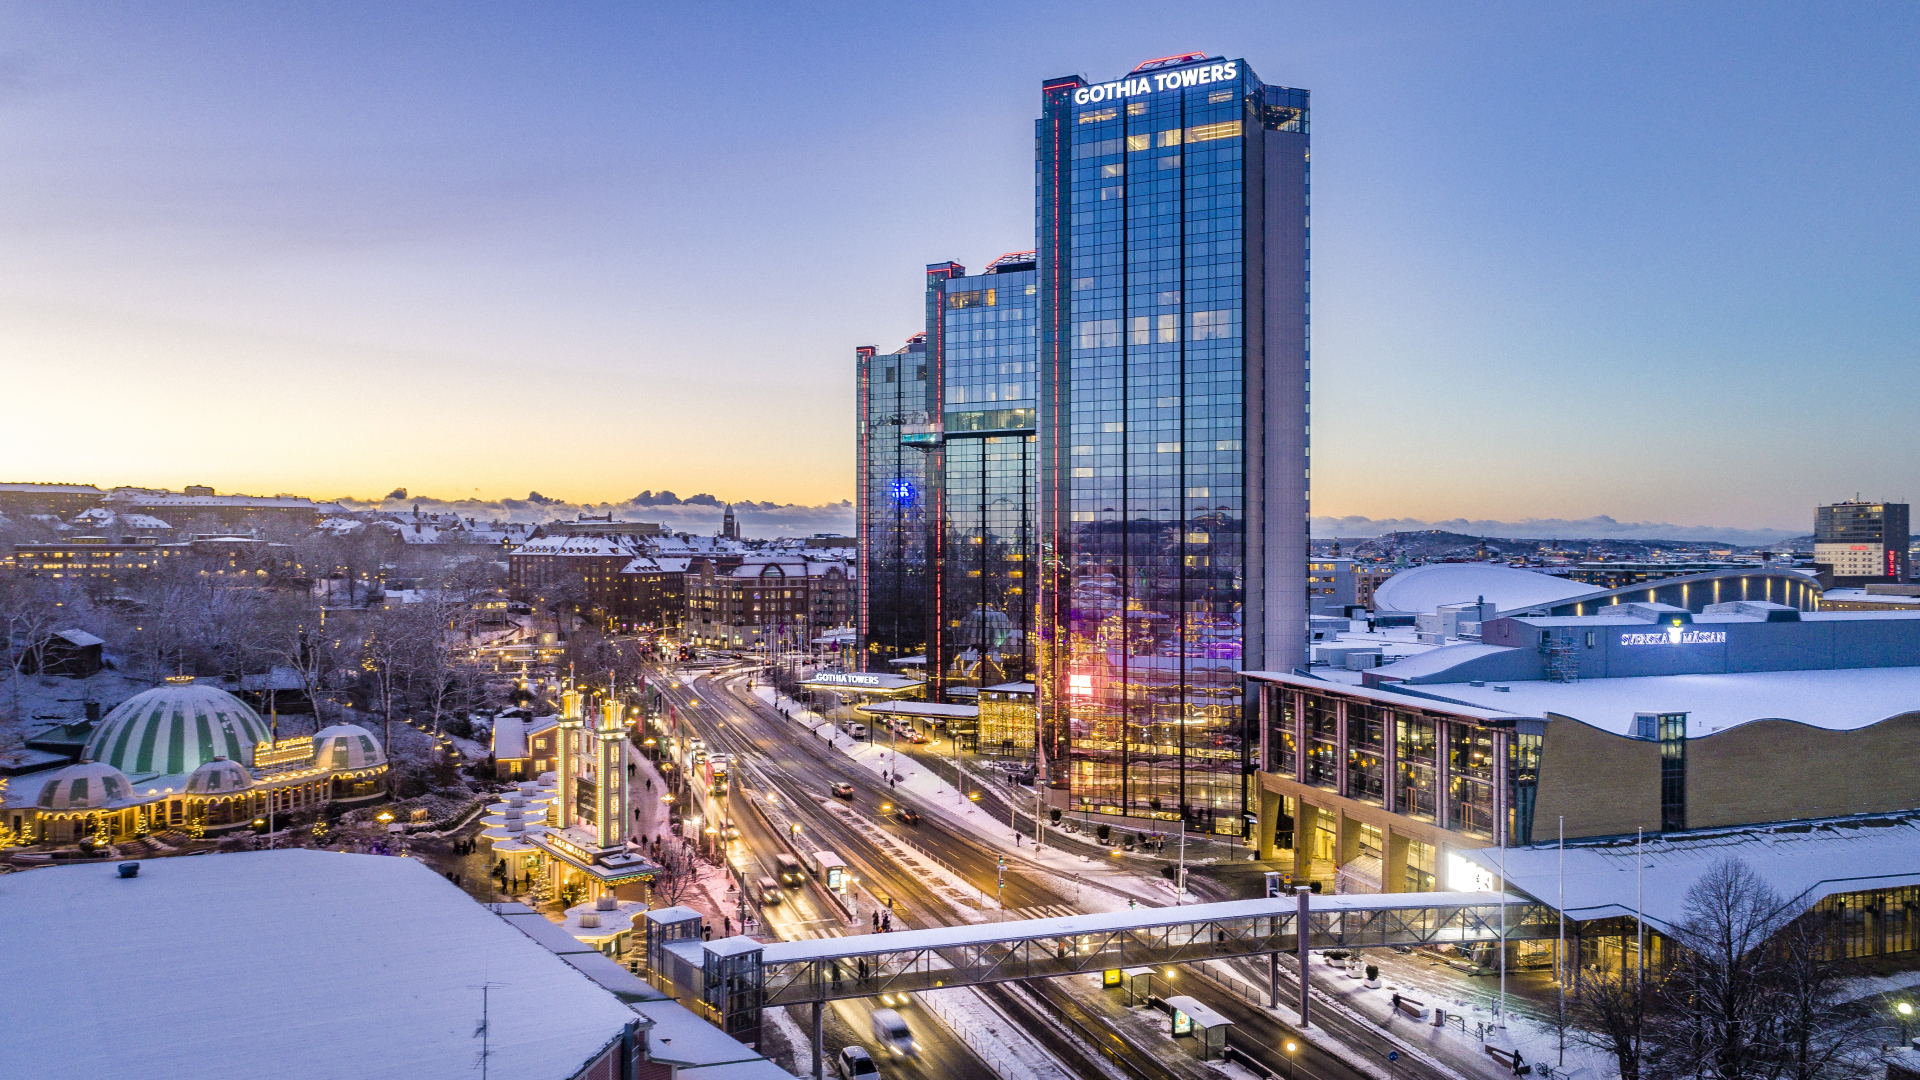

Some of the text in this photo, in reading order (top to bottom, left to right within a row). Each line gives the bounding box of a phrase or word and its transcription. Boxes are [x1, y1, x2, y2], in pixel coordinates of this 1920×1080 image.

[1074, 62, 1237, 105] GOTHIA TOWERS
[1621, 633, 1668, 645] SVENSKA
[816, 673, 879, 684] GOTHIA TOWERS
